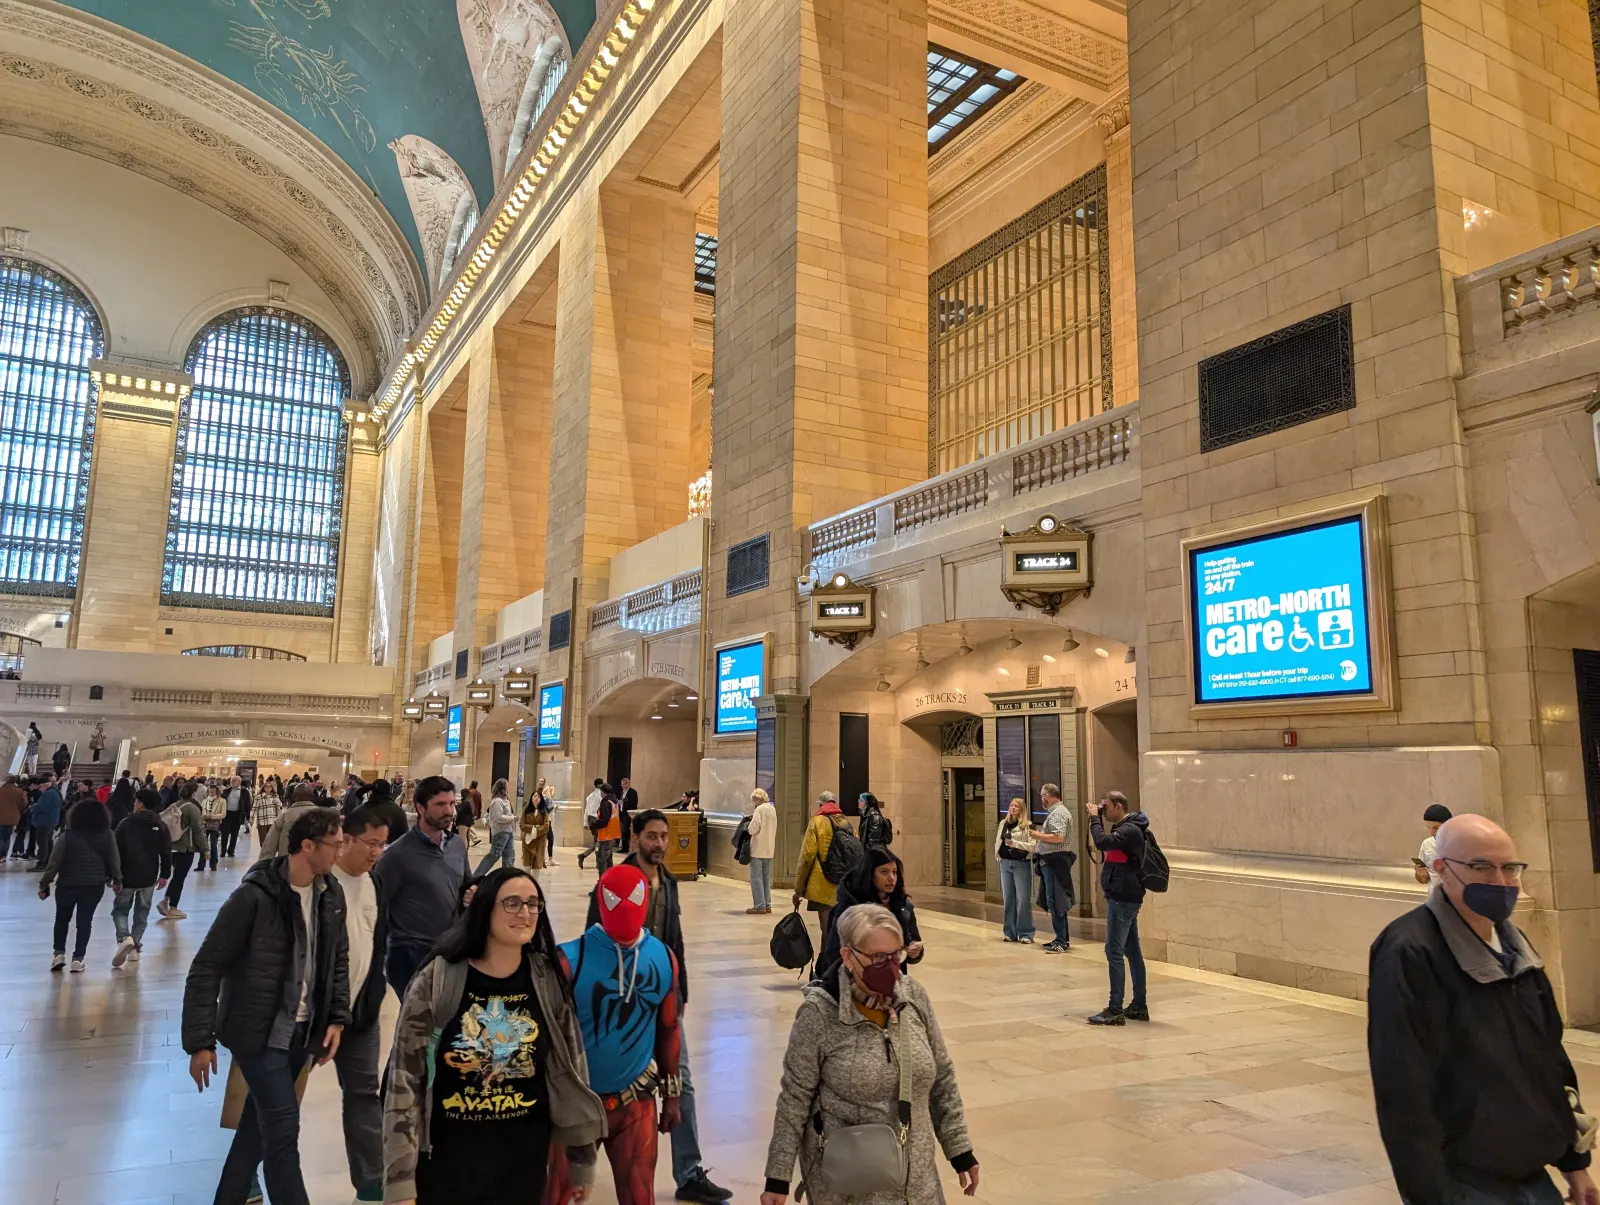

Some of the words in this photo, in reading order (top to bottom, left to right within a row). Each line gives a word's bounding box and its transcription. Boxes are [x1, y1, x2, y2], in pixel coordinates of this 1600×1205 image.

[1022, 557, 1058, 567] TRACK
[1060, 557, 1071, 566] 24
[1204, 577, 1235, 595] 24/7
[825, 607, 850, 615] TRACK
[851, 606, 859, 614] 25
[1206, 583, 1351, 625] METRO-NORTH
[1206, 619, 1285, 657] care
[664, 664, 685, 678] STREET
[1211, 673, 1223, 681] Call
[1261, 668, 1282, 677] before
[1282, 667, 1297, 677] your
[1297, 667, 1309, 675] trip
[1114, 677, 1128, 692] 24
[720, 690, 742, 709] care
[915, 697, 924, 707] 26
[924, 692, 957, 705] TRACKS
[958, 693, 967, 704] 25
[165, 732, 194, 742] TICKET
[197, 729, 240, 738] MACHINES
[267, 730, 298, 740] TRACKS
[247, 748, 278, 757] WAITING
[279, 751, 300, 760] ROOM
[442, 1092, 538, 1113] AVATAR
[446, 1111, 460, 1120] THE
